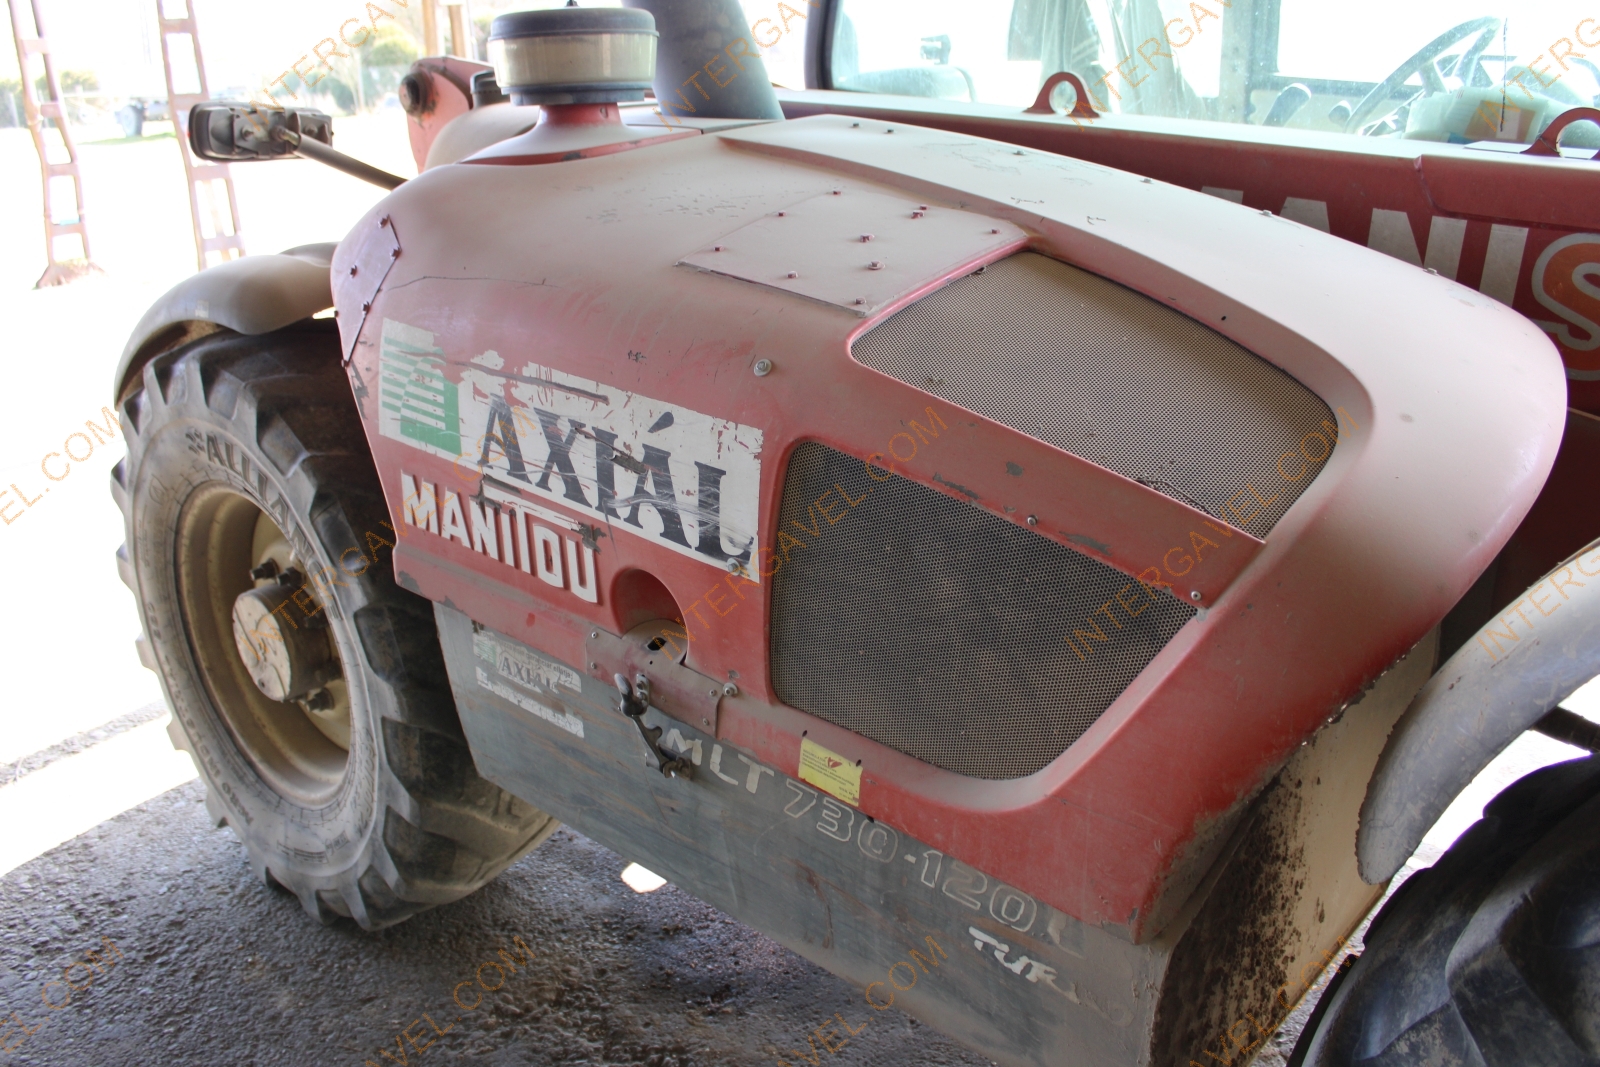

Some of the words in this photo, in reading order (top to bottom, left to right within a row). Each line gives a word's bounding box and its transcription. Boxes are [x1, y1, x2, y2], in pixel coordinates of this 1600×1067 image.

[401, 472, 599, 604] MANITOU
[666, 728, 775, 794] MLT
[783, 777, 1038, 932] 730-120
